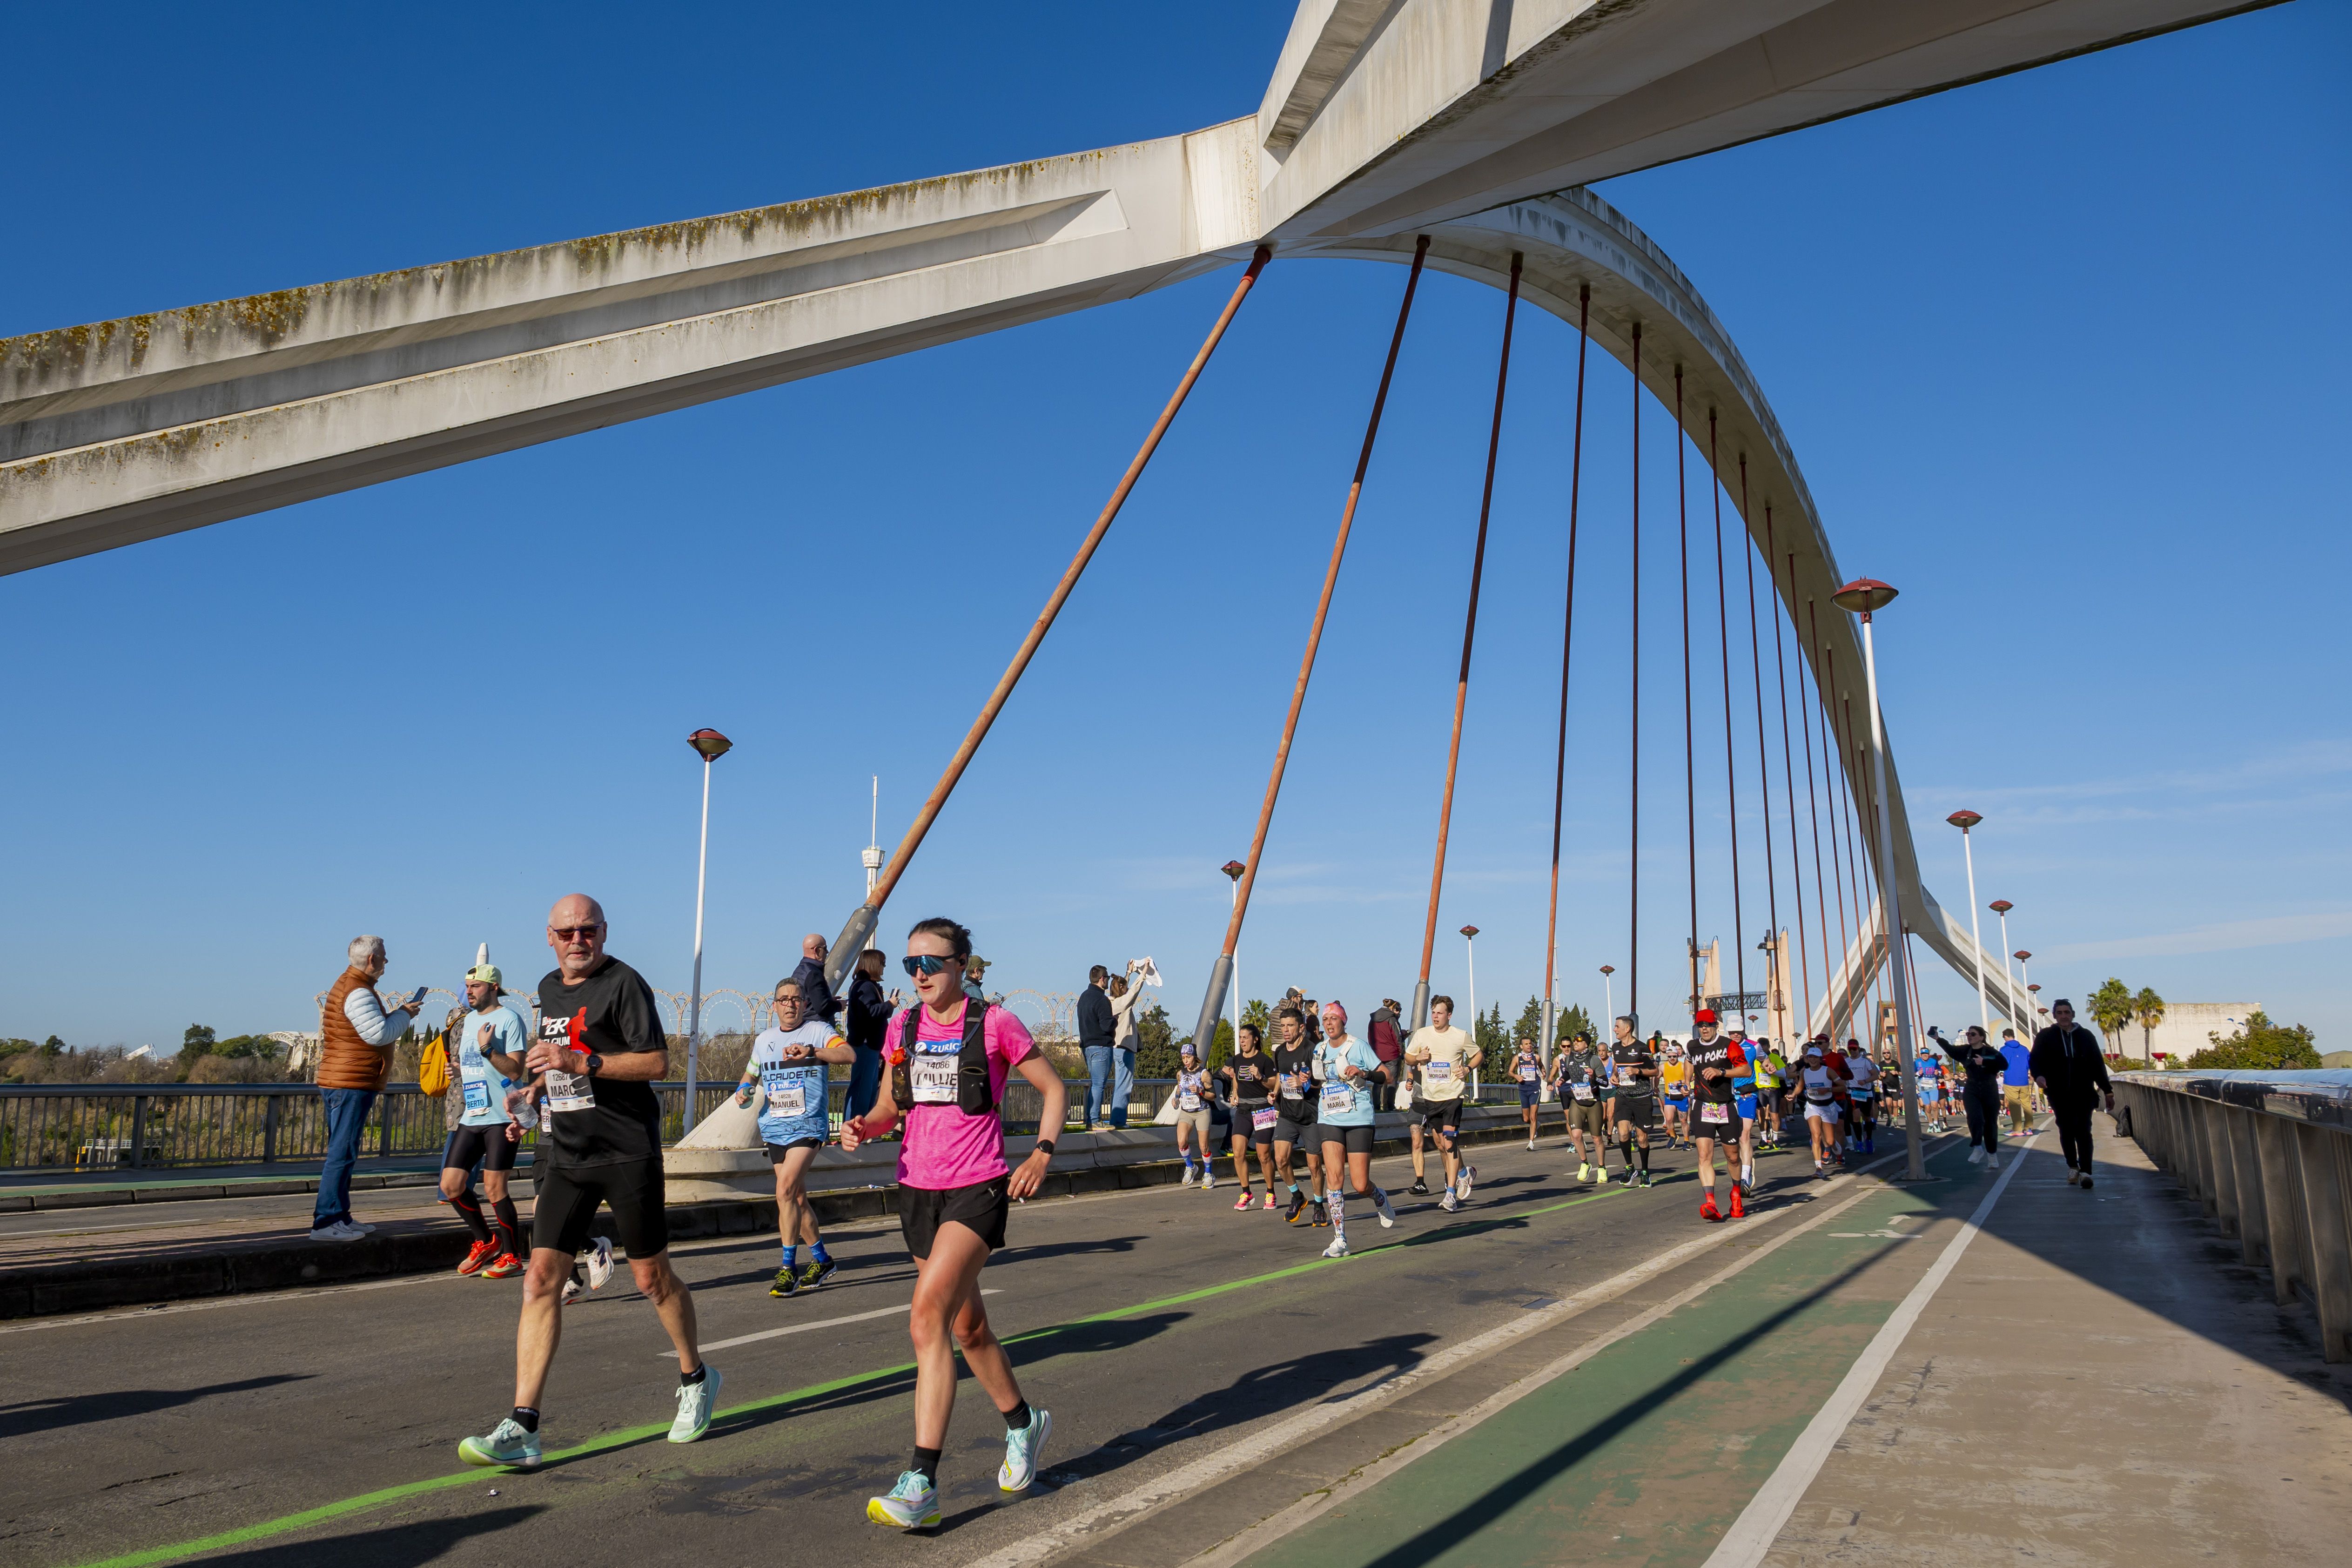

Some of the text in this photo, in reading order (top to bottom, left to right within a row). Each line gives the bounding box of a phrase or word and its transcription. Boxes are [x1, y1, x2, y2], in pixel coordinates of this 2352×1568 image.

[930, 1043, 961, 1052] ZURIC
[916, 1073, 958, 1086] MILLIE
[551, 1084, 578, 1097] MARC
[772, 1100, 800, 1109] MANUEL
[1327, 1100, 1345, 1110] MARÍA
